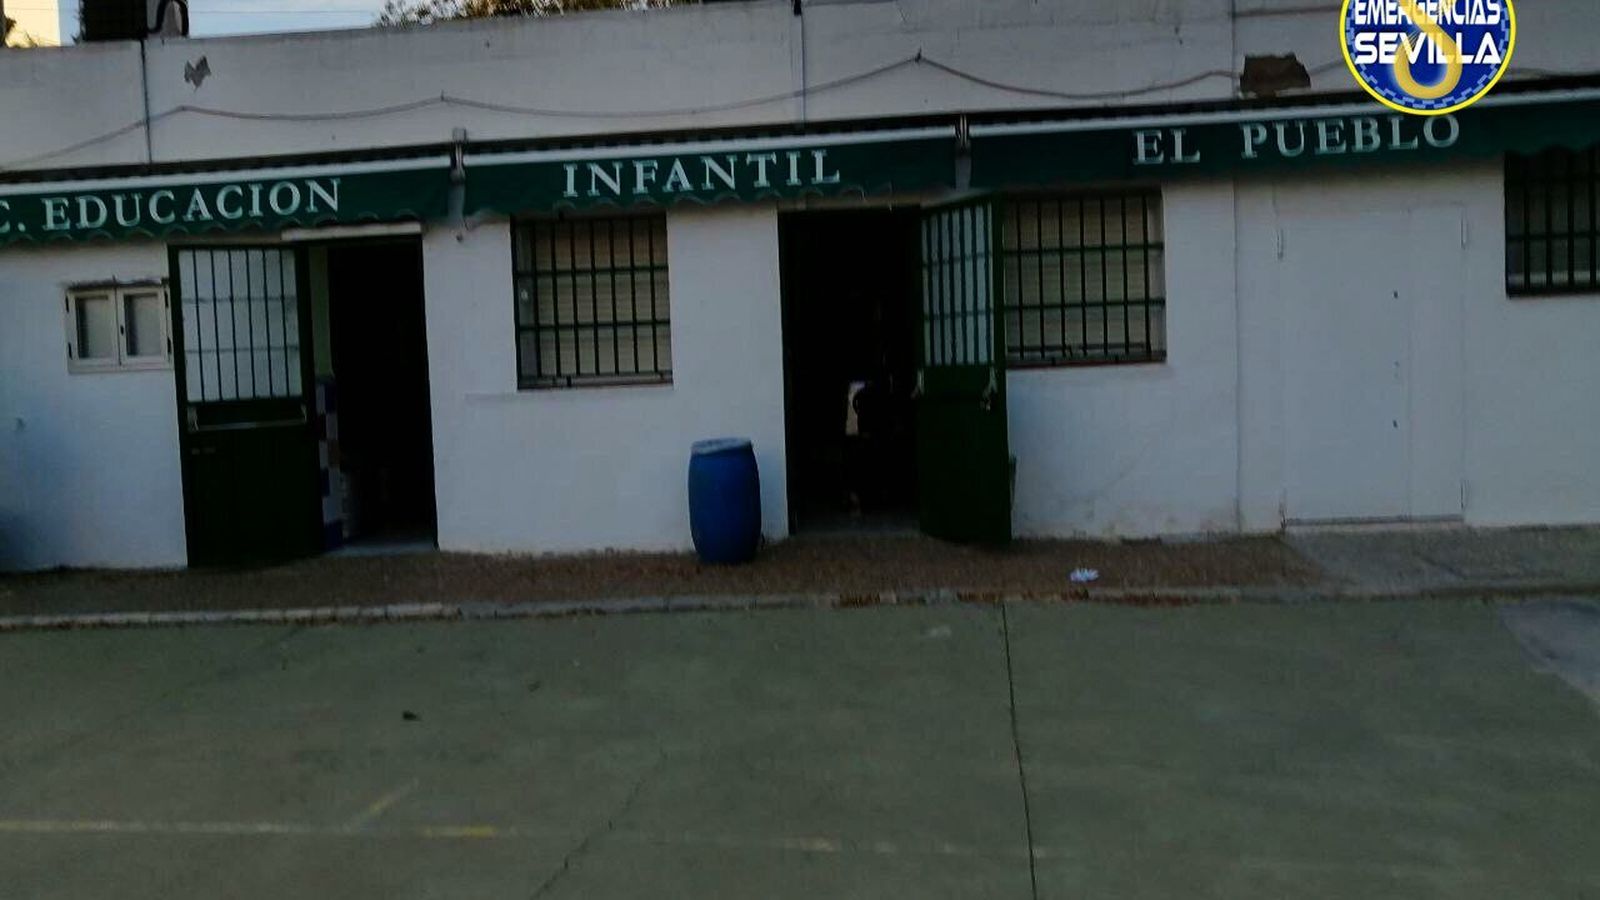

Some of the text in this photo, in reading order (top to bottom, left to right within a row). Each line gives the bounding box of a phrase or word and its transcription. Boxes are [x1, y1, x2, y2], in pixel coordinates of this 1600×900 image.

[40, 178, 341, 231] EDUCACION
[563, 150, 840, 198] INFANTIL
[1133, 128, 1200, 165] EL
[1239, 114, 1460, 159] PUEBLO
